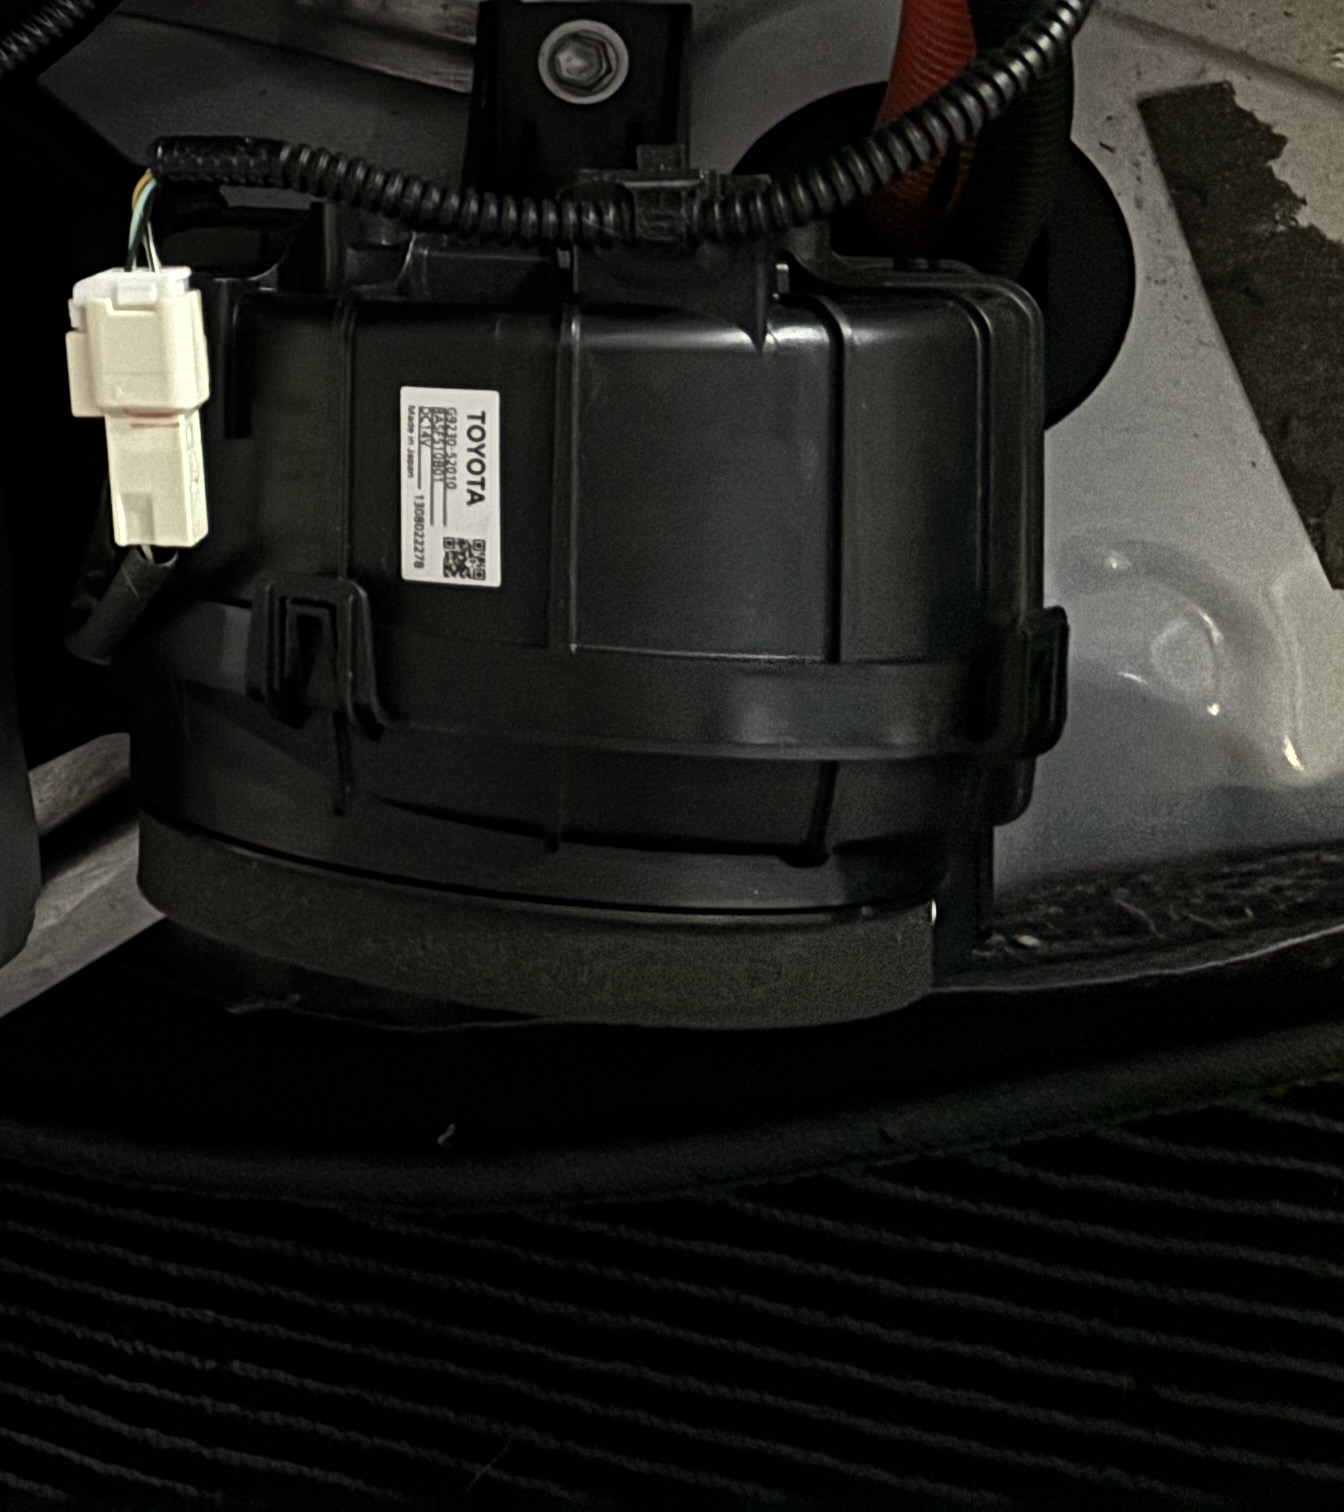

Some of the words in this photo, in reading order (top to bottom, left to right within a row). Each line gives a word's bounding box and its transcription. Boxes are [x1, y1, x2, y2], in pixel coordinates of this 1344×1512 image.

[407, 404, 416, 434] Made
[406, 447, 416, 479] Japan
[445, 407, 458, 490] G9230-52010
[466, 410, 486, 506] TOYOTA
